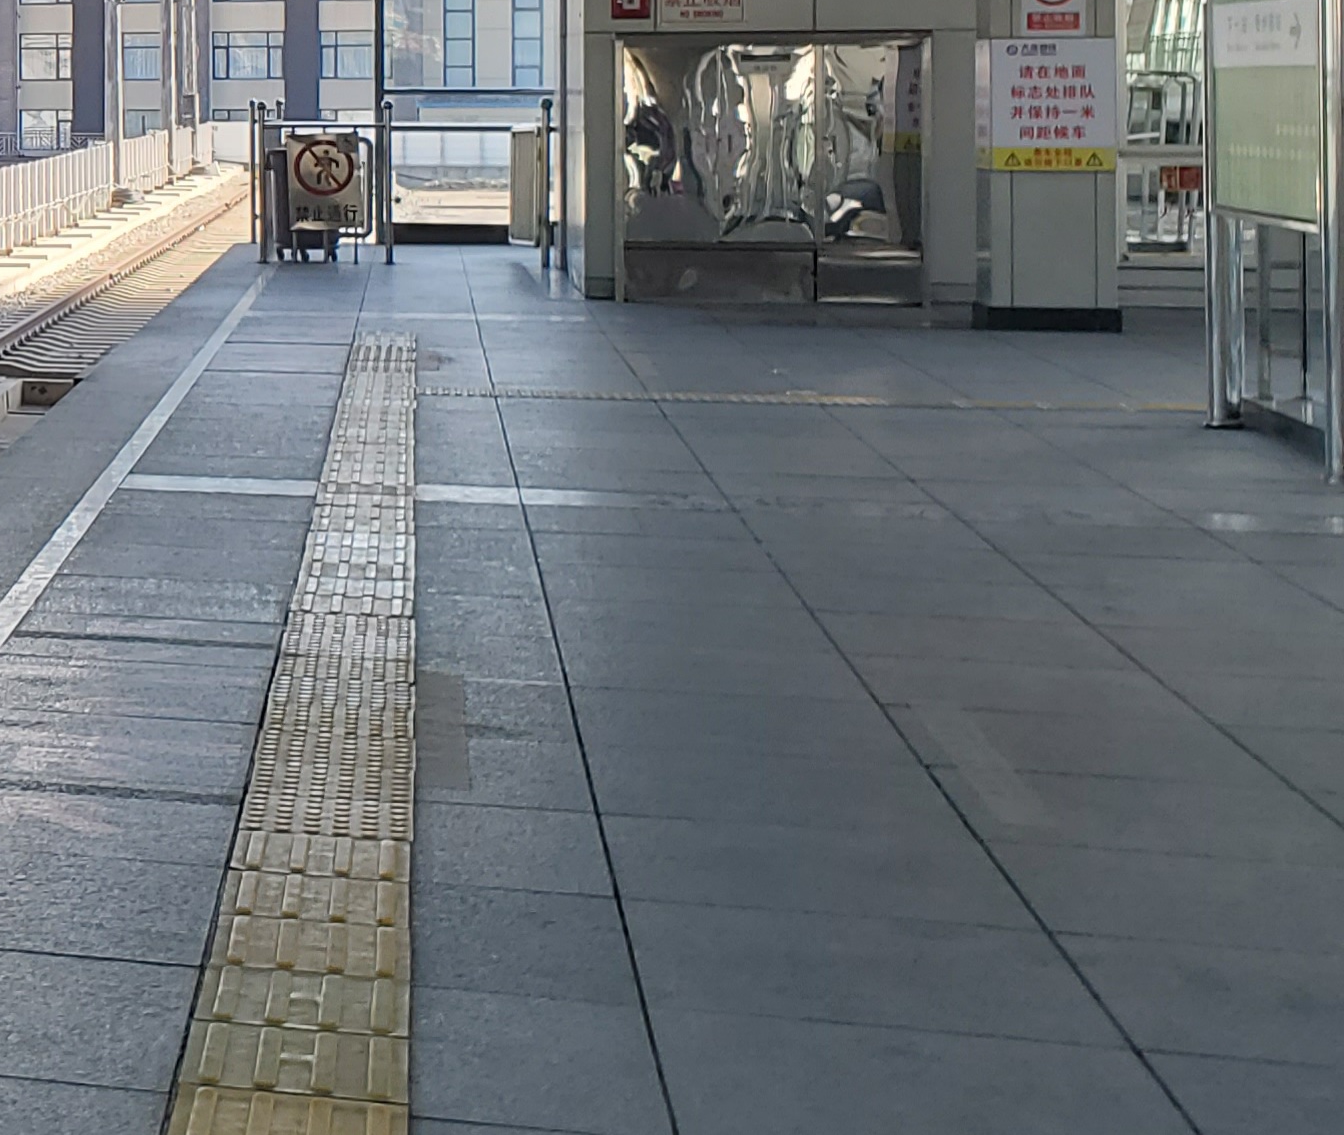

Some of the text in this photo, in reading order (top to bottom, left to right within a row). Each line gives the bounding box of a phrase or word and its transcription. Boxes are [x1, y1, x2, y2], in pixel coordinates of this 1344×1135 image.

[1019, 65, 1087, 79] 请在地面
[1010, 85, 1096, 100] 标志处排队
[1010, 105, 1096, 120] 并保持一米
[1019, 125, 1087, 141] 间距候车
[295, 204, 359, 223] 禁止通行
